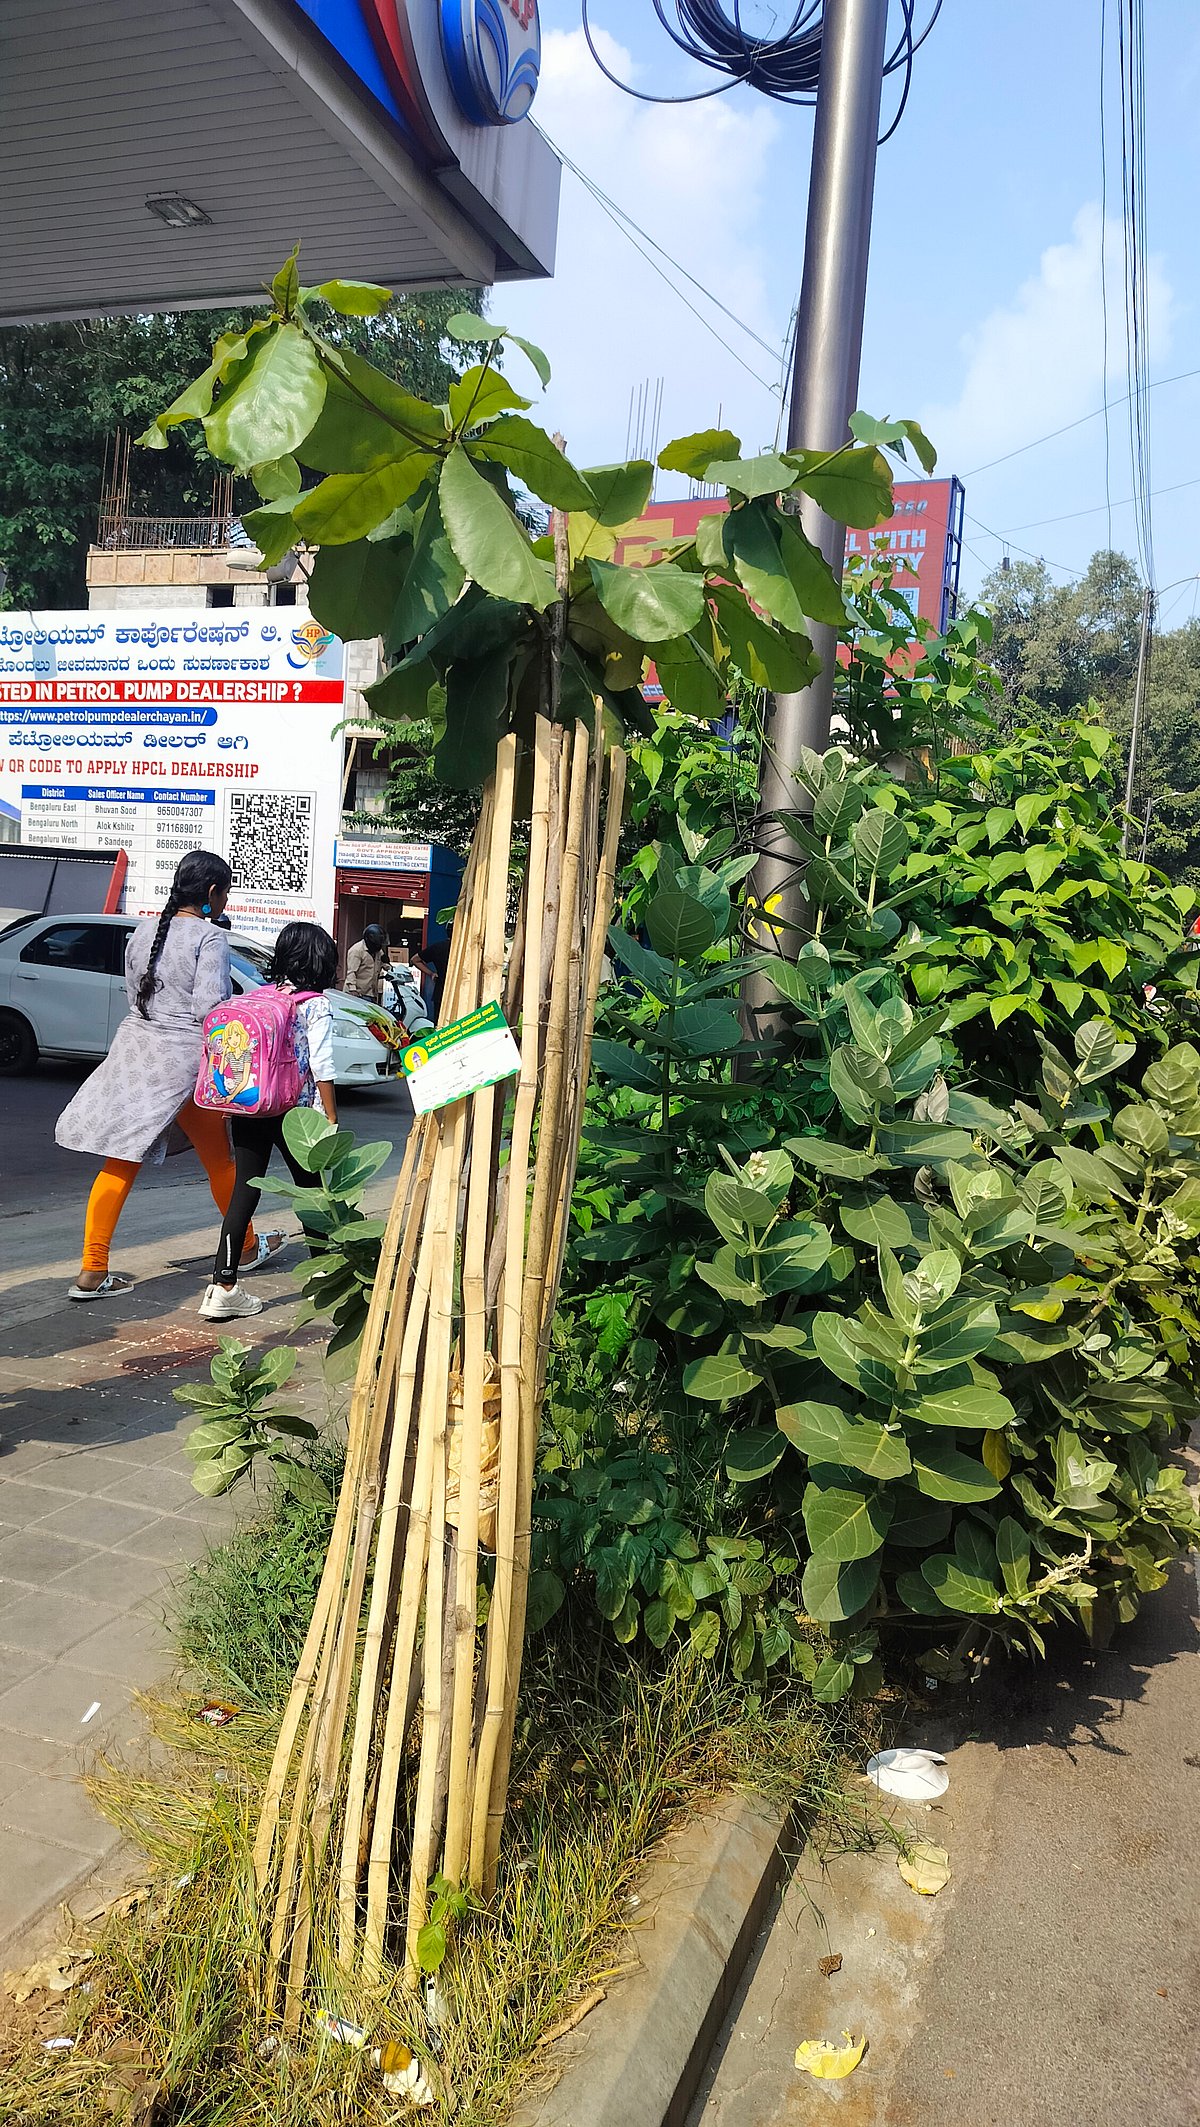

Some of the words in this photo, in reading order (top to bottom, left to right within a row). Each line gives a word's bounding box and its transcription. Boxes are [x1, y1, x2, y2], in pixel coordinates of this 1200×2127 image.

[868, 528, 927, 550] WITH
[306, 628, 321, 638] HP
[57, 656, 131, 672] ಜೀವಮಾನದ
[137, 655, 176, 671] ಒಂದು
[0, 682, 33, 701] TED
[36, 682, 53, 701] IN
[56, 682, 120, 701] PETROL
[124, 682, 173, 701] PUMP
[176, 682, 289, 702] DEALERSHIP
[292, 682, 303, 702] ?
[9, 730, 133, 752] ಪೆಟ್ರೋಲಿಯಮ್
[143, 733, 207, 749] ಡೀಲರ್
[217, 735, 249, 750] ಆಗಿ
[9, 759, 25, 773] QR
[29, 759, 62, 773] CODE
[66, 760, 82, 774] TO
[87, 761, 128, 775] APPLY
[132, 761, 167, 776] HPCL
[171, 762, 259, 778] DEALERSHIP
[41, 788, 65, 798] District
[88, 790, 105, 799] Sales
[106, 790, 126, 799] Officer
[126, 791, 145, 800] Name
[153, 791, 180, 801] Contact
[180, 792, 208, 802] Number
[30, 802, 62, 812] Bengaluru
[63, 803, 77, 812] East
[95, 805, 119, 814] Bhuvan
[120, 806, 137, 815] Sood
[157, 806, 203, 817] 9650047307
[28, 818, 60, 829] Bengaluru
[60, 819, 78, 828] North
[96, 821, 112, 830] Alok
[112, 822, 135, 831] Kshitiz
[28, 834, 60, 844] Bengaluru
[61, 835, 77, 844] West
[104, 837, 133, 848] Sandeep
[248, 906, 267, 914] RETAIL
[268, 908, 295, 917] REGIONAL
[296, 909, 316, 918] OFFICE
[236, 914, 254, 922] Madras
